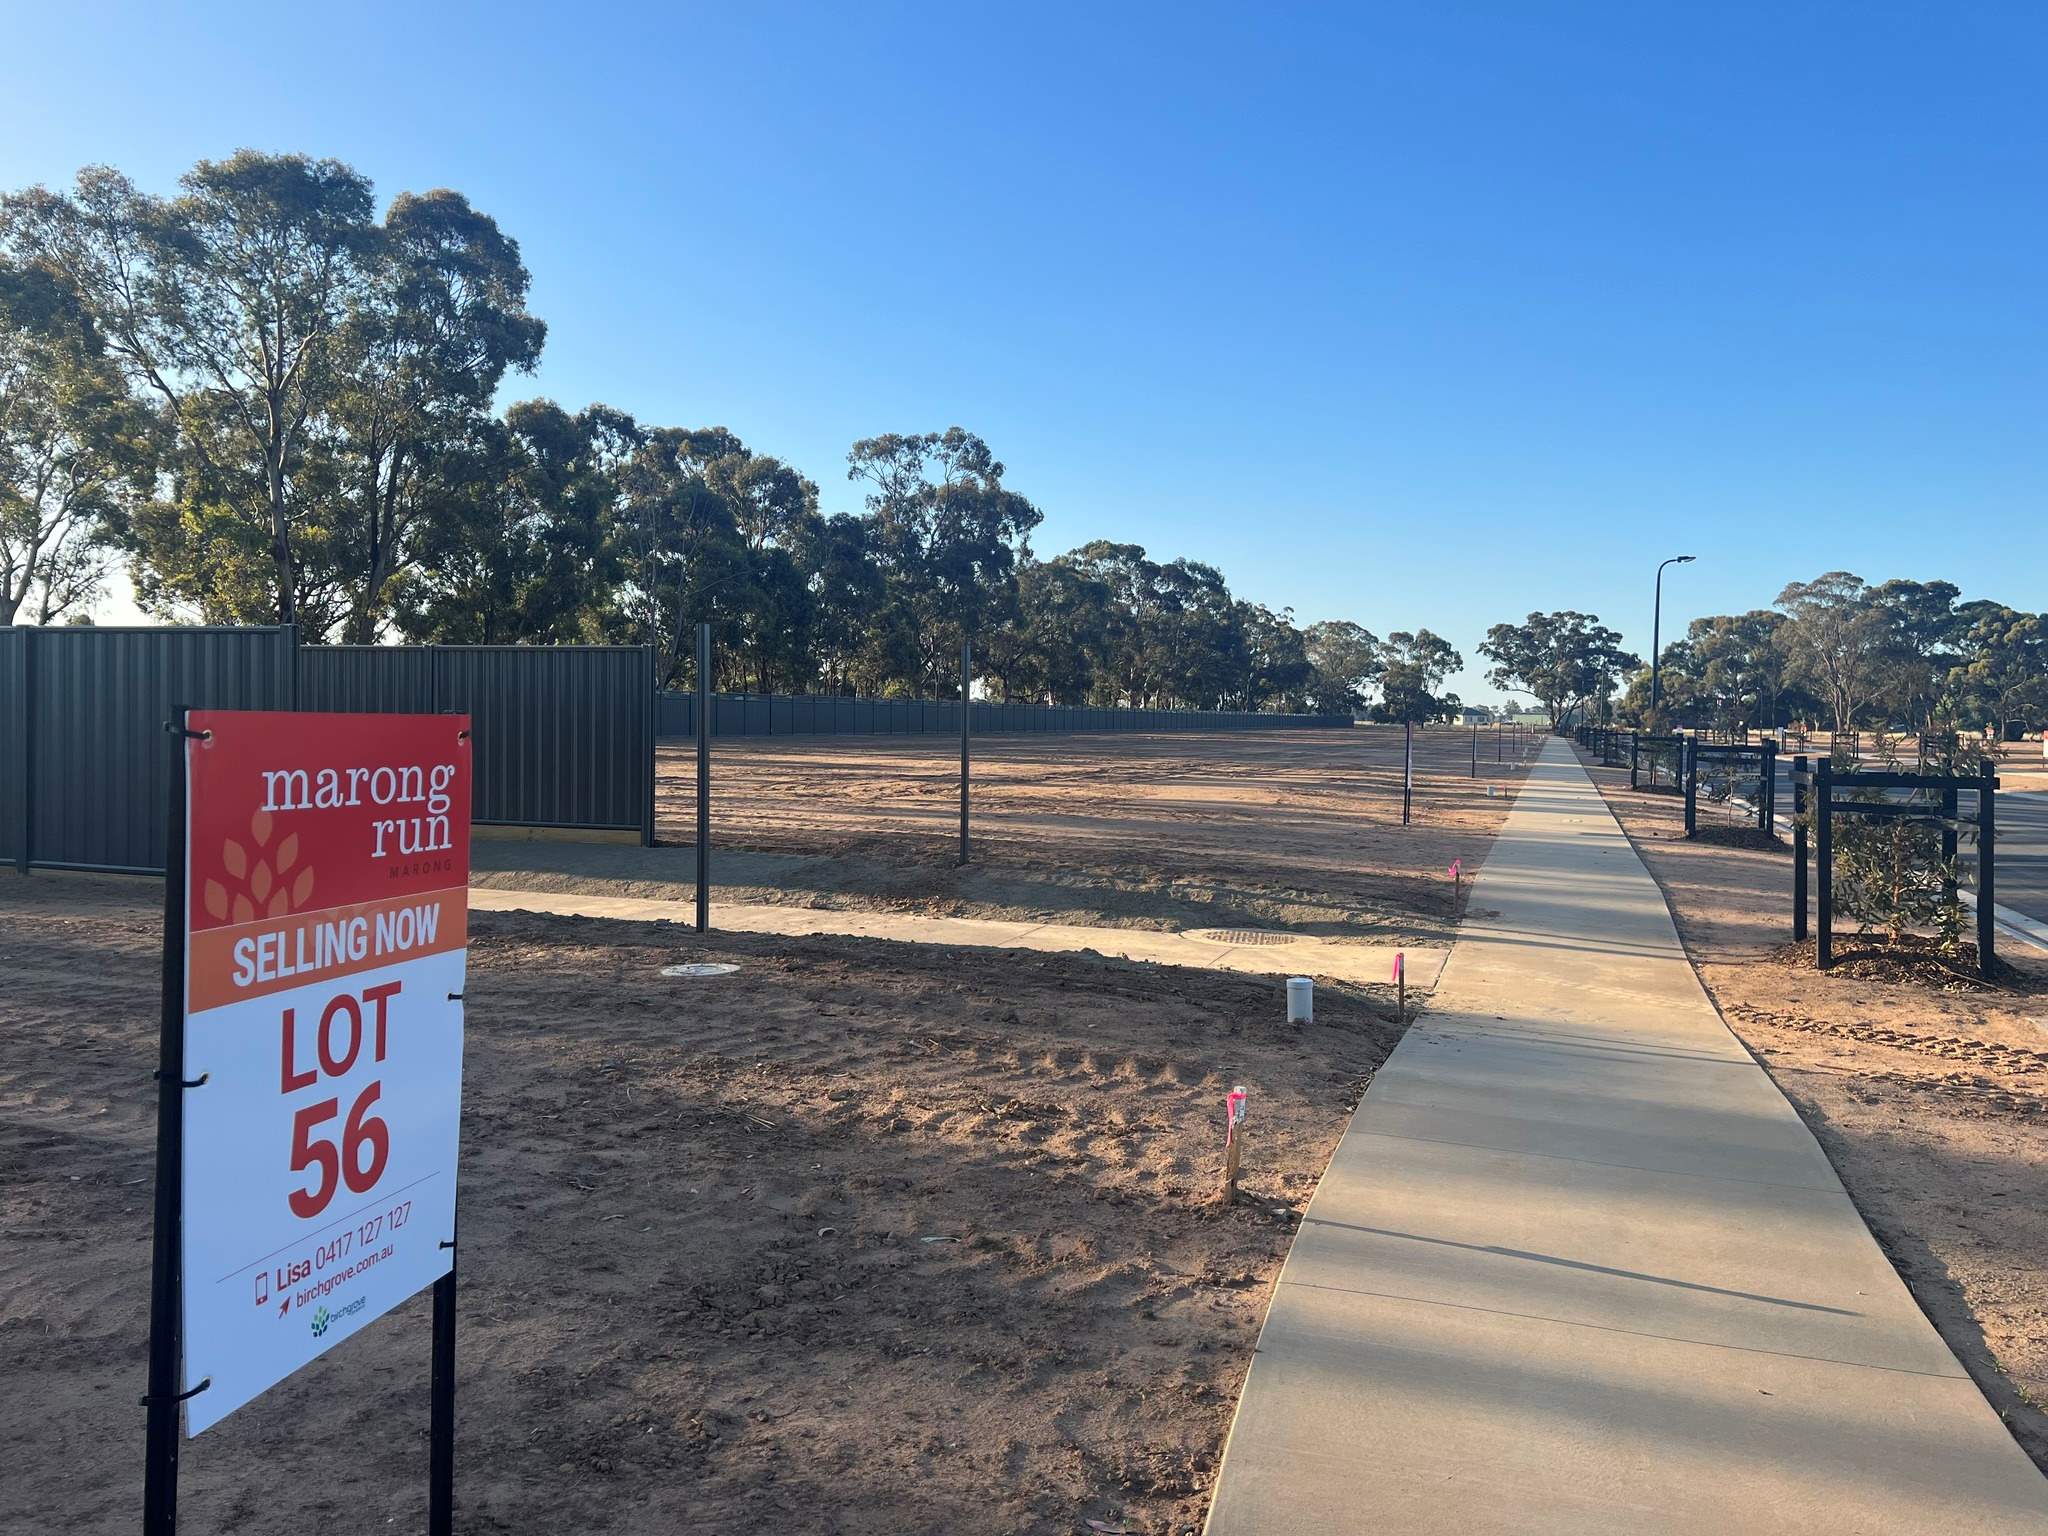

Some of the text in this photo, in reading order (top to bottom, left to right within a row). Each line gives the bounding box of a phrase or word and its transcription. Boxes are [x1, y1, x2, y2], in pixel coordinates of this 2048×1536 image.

[261, 763, 455, 814] marong
[371, 813, 453, 858] run
[389, 859, 452, 879] MARONG
[232, 903, 440, 988] SELLING NOW
[281, 980, 402, 1094] LOT
[288, 1079, 389, 1219] 56
[276, 1200, 412, 1292] Lisa 0417 127 127
[296, 1244, 394, 1309] birchgrove.com.au
